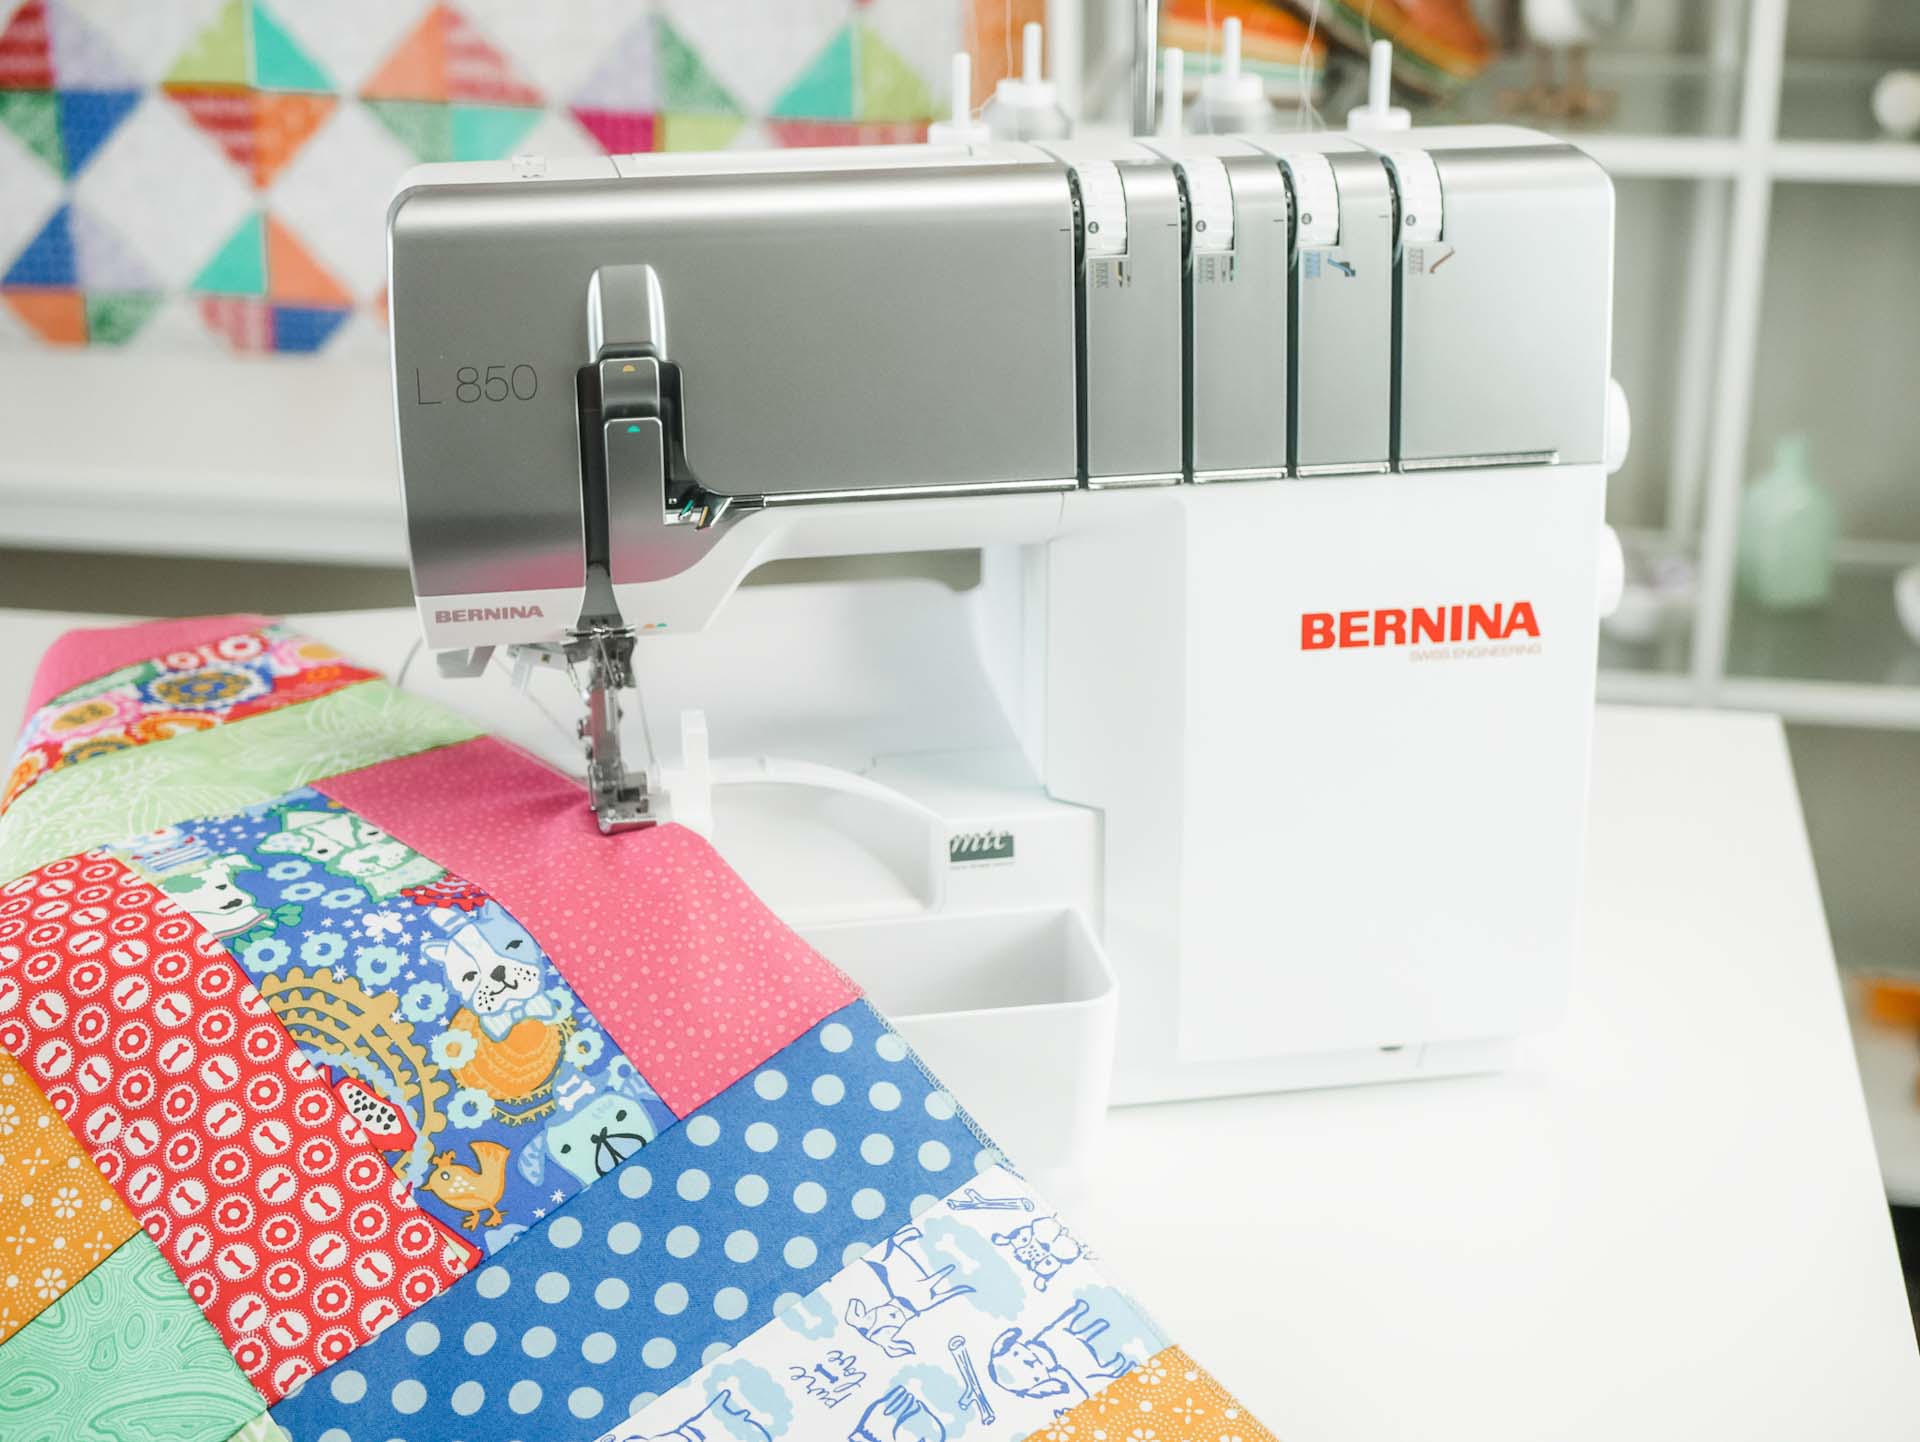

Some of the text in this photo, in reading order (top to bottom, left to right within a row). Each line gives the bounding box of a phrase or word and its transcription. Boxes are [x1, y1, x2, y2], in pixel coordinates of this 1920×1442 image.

[416, 363, 539, 405] L 850
[435, 604, 544, 624] BERNINA
[1300, 601, 1541, 650] BERNINA
[1409, 642, 1542, 662] SWISS ENGINEERING
[789, 1366, 852, 1409] pure
[826, 1350, 867, 1392] love
